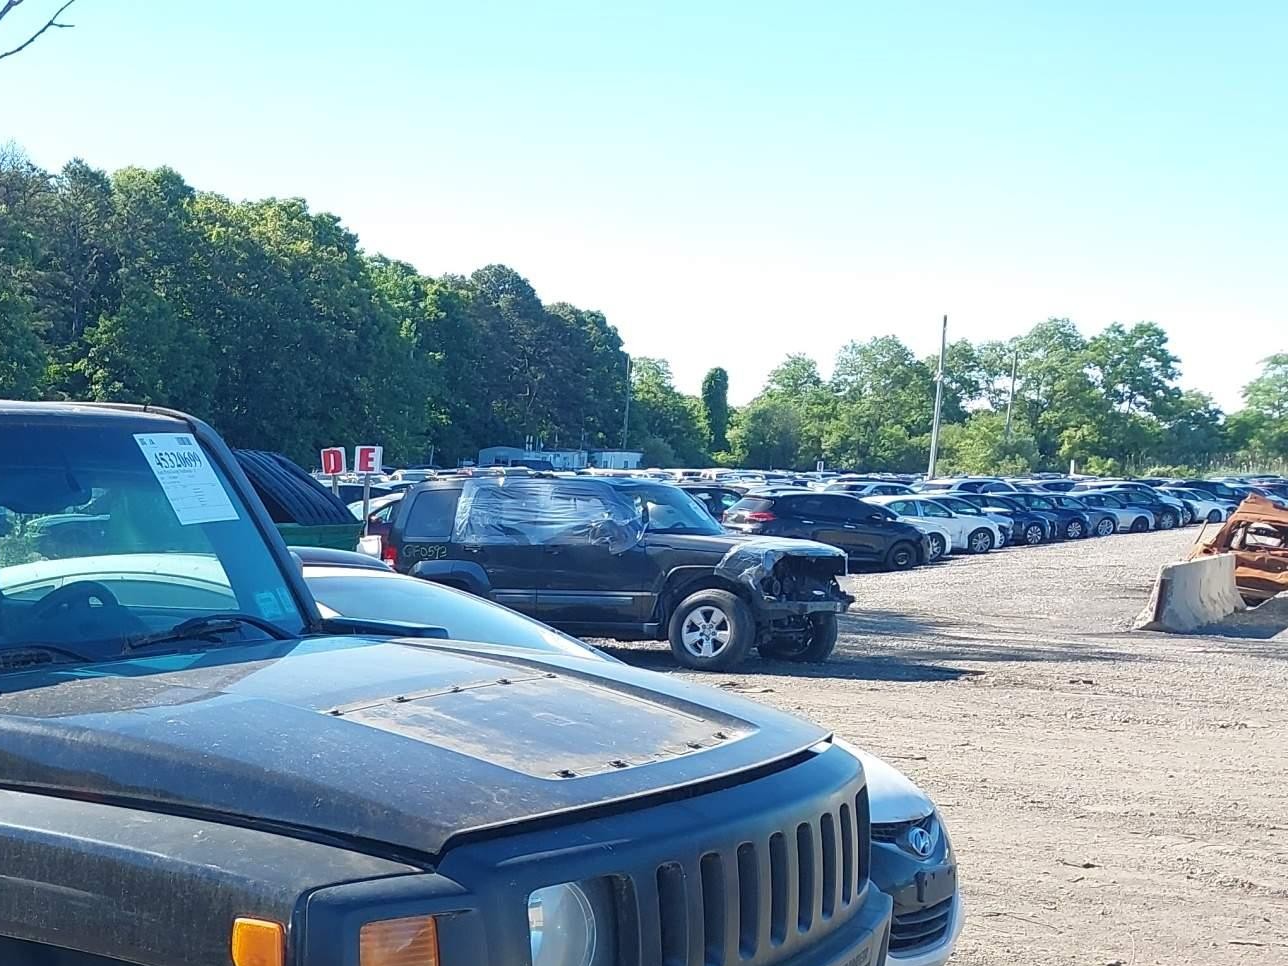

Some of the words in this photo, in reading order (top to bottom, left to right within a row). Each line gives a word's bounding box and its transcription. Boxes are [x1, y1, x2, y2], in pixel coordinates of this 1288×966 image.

[154, 451, 202, 468] 45320699
[323, 449, 343, 474] D
[359, 448, 376, 471] E
